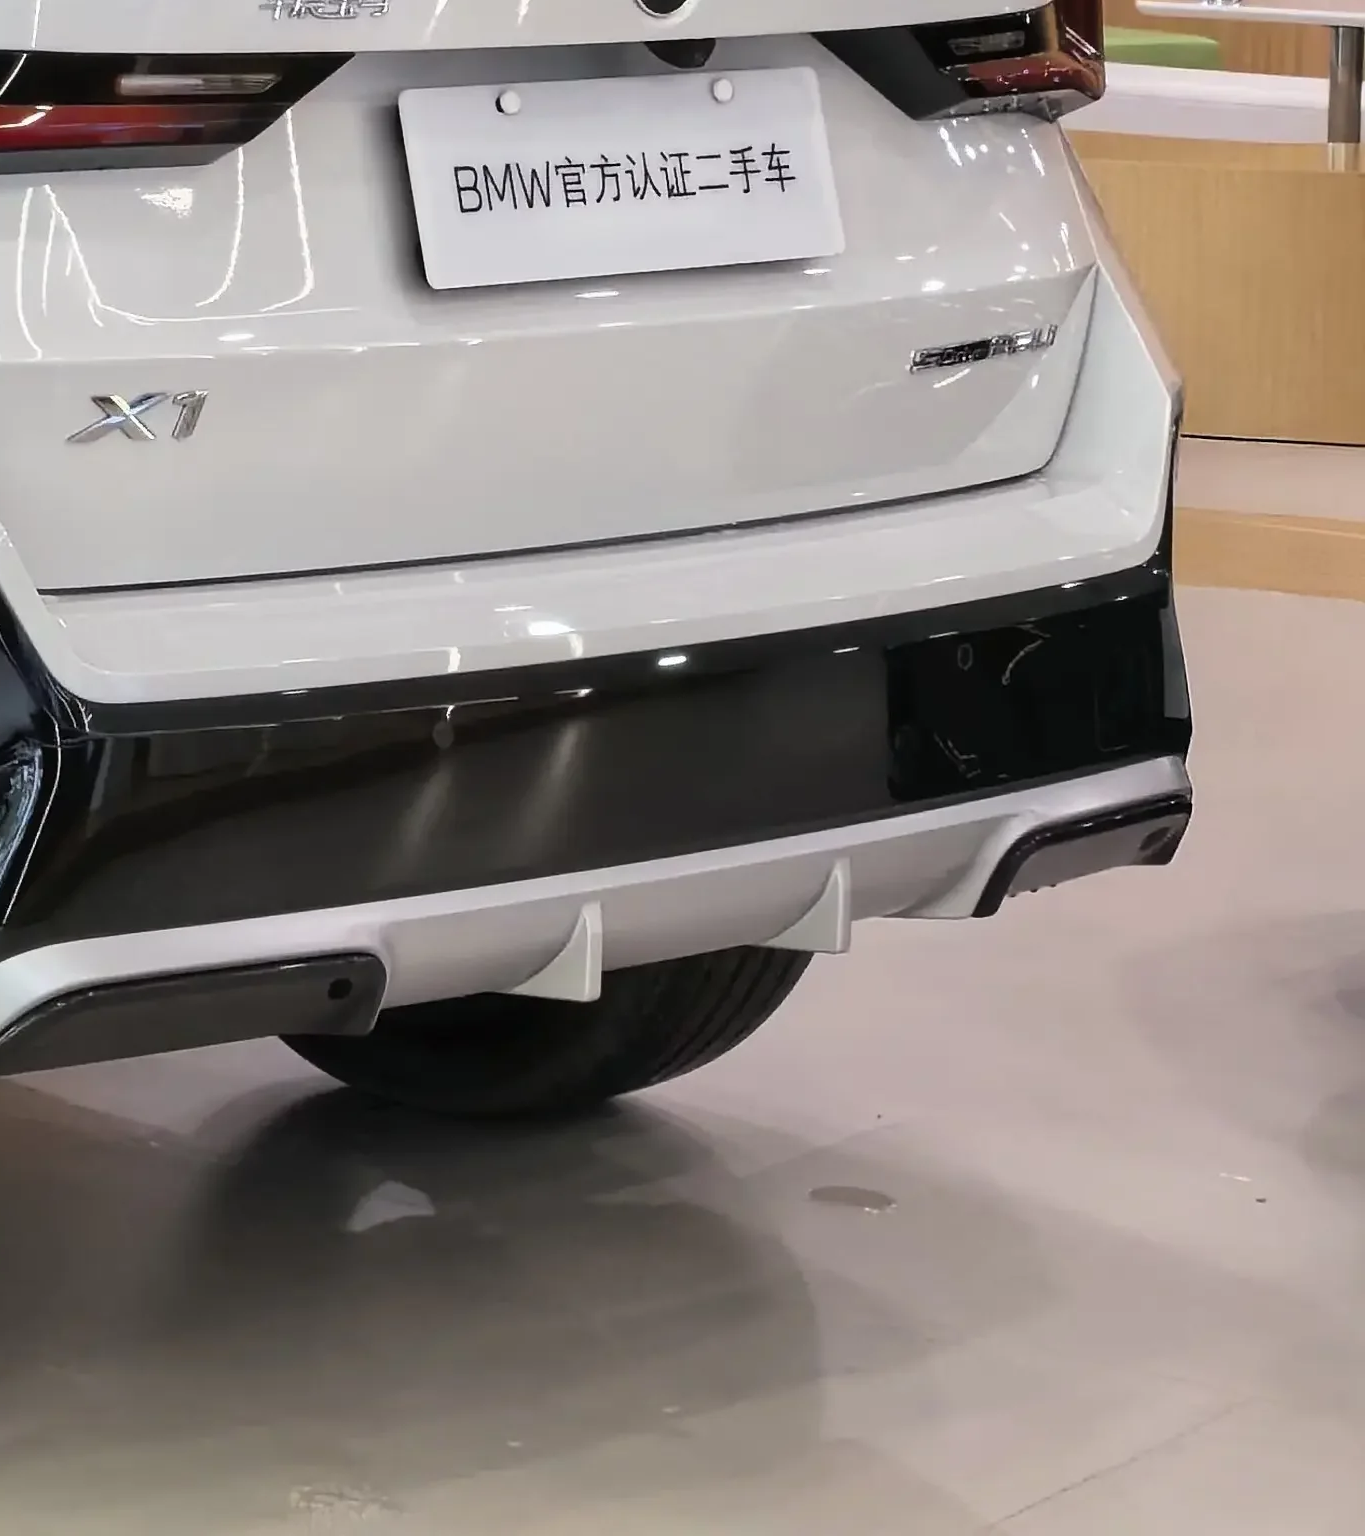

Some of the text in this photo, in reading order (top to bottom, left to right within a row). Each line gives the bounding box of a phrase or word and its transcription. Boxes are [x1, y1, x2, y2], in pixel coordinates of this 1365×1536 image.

[453, 143, 797, 213] BMW官方认证二手车
[66, 388, 209, 443] X1
